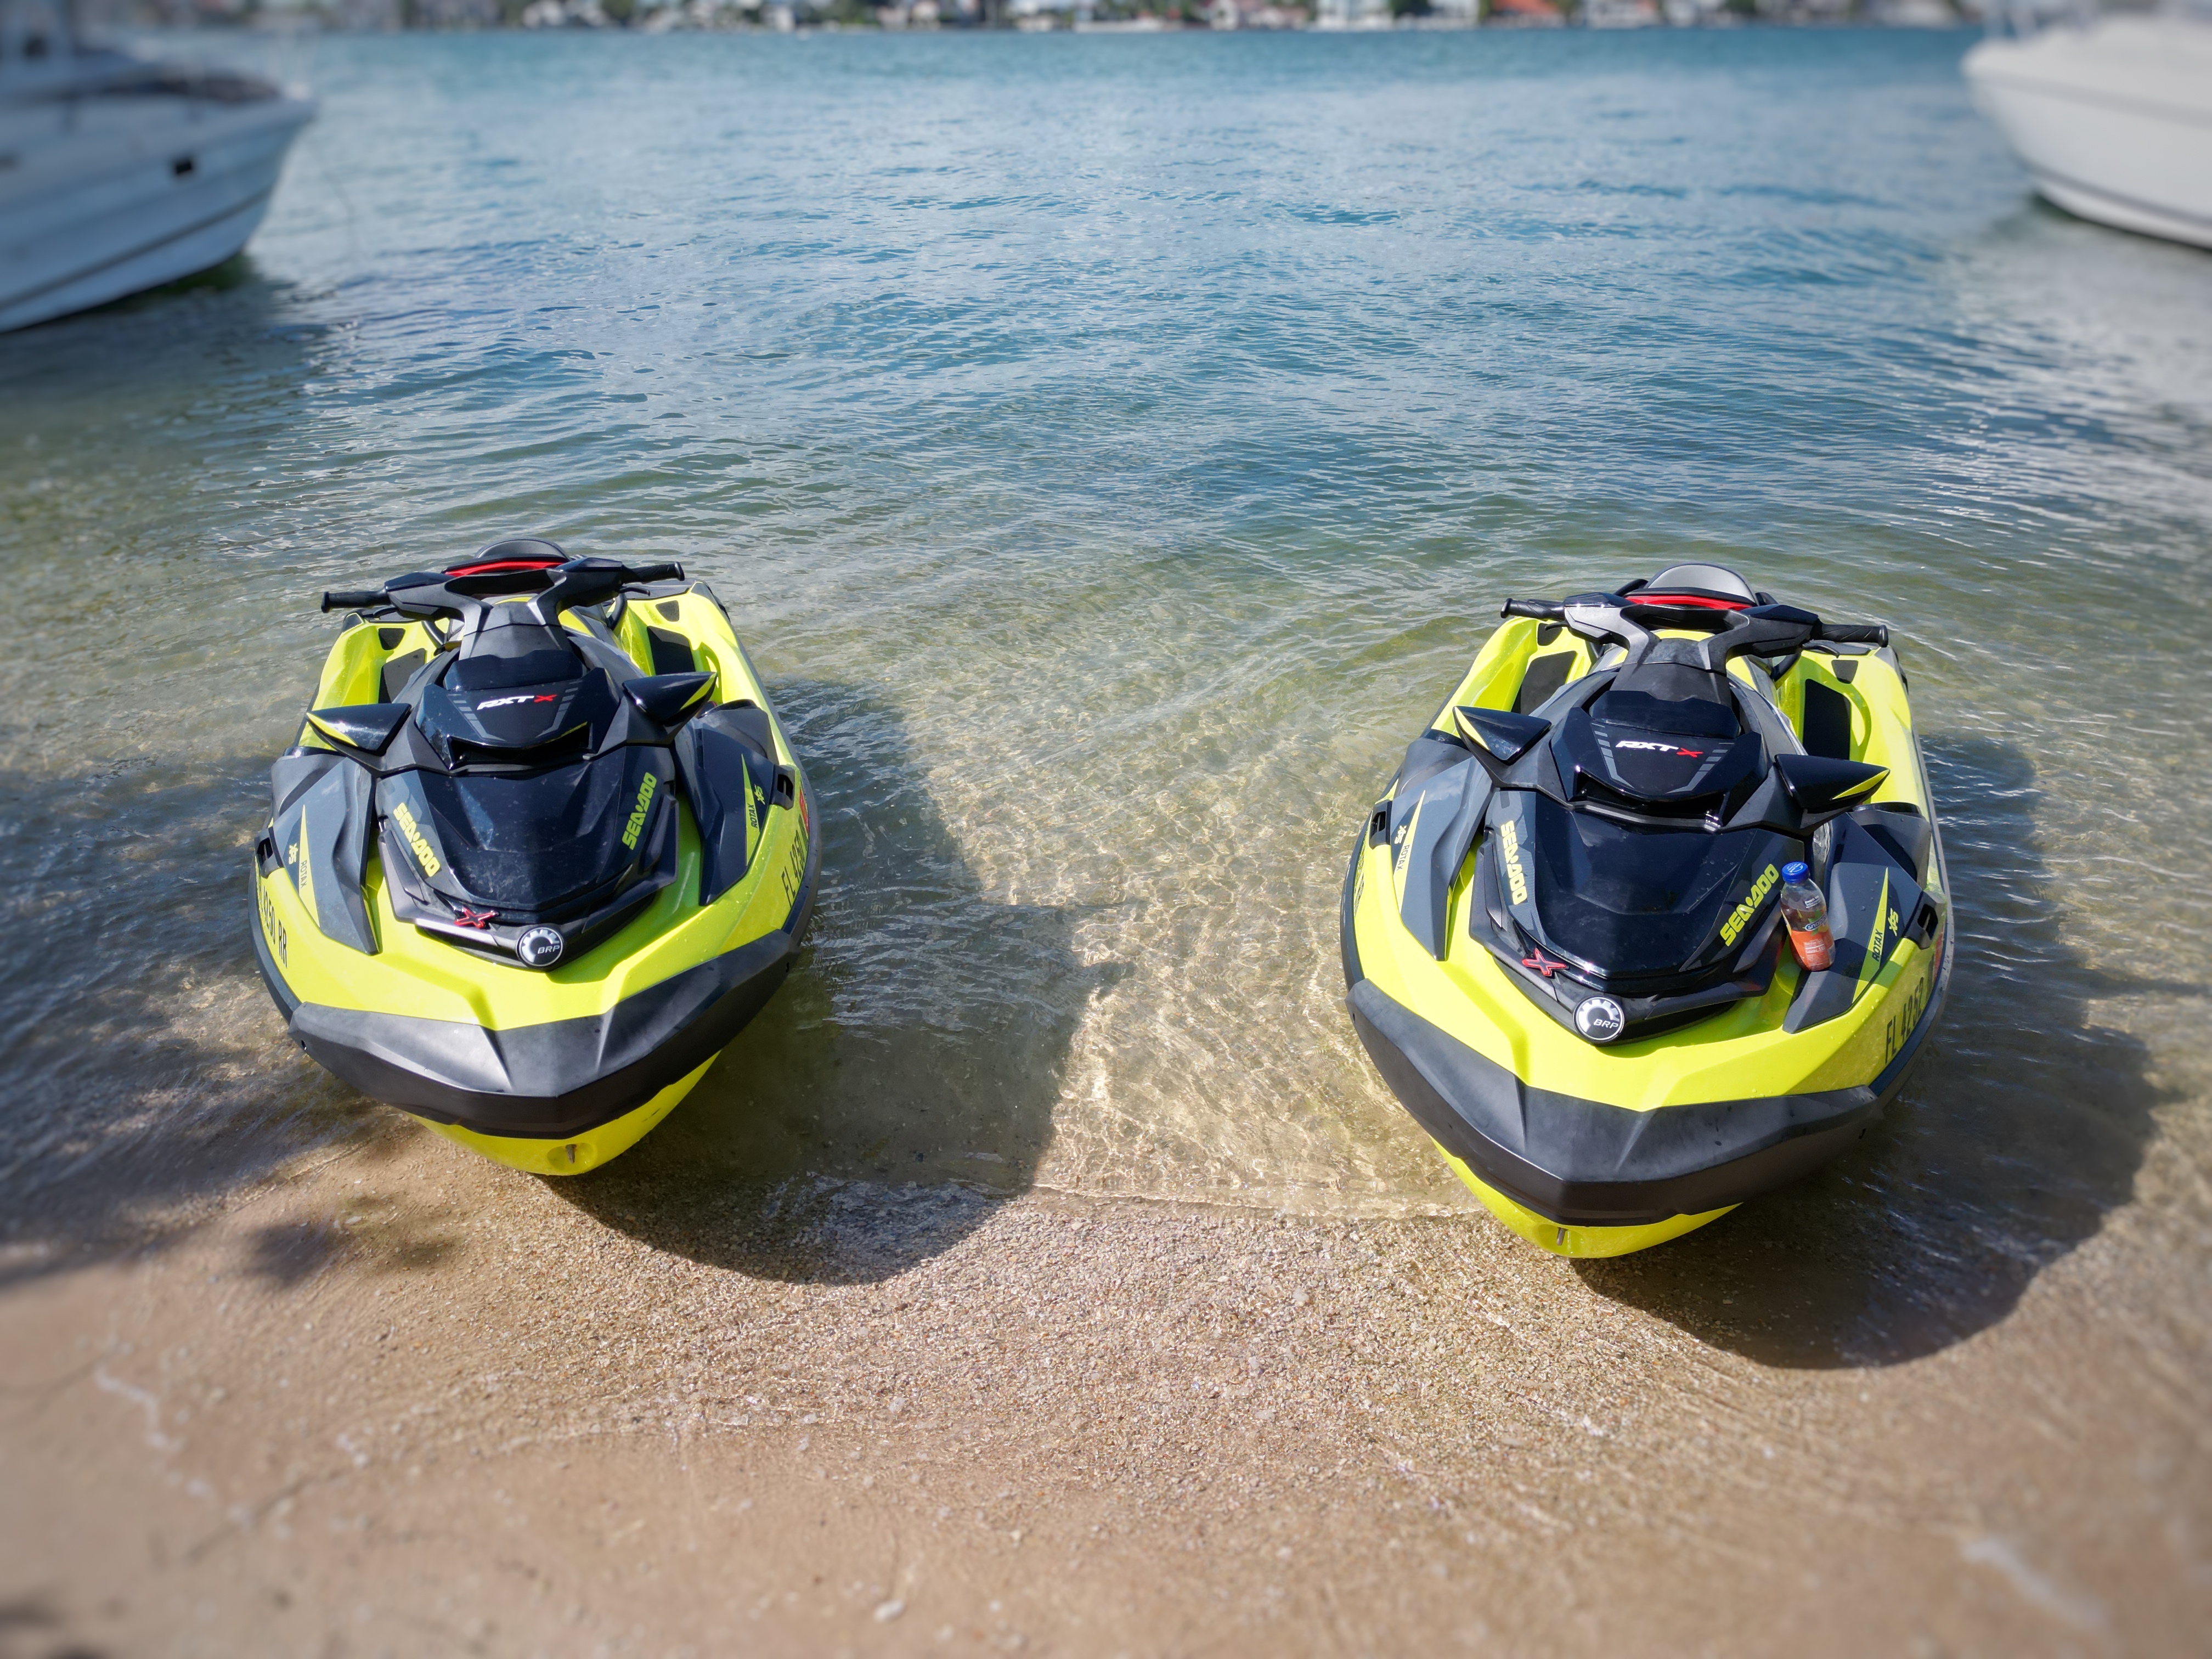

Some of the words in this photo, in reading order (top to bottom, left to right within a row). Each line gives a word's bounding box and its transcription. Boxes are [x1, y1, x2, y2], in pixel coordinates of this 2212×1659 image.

[476, 695, 534, 711] RXT
[1615, 740, 1679, 752] RXT
[747, 803, 758, 828] ROTAX
[1396, 844, 1410, 871] ROTAX
[278, 918, 288, 969] RR
[538, 945, 560, 955] BRP
[1872, 928, 1883, 962] ROTAX
[1593, 1018, 1619, 1029] BRP
[1885, 1015, 1897, 1064] FL
